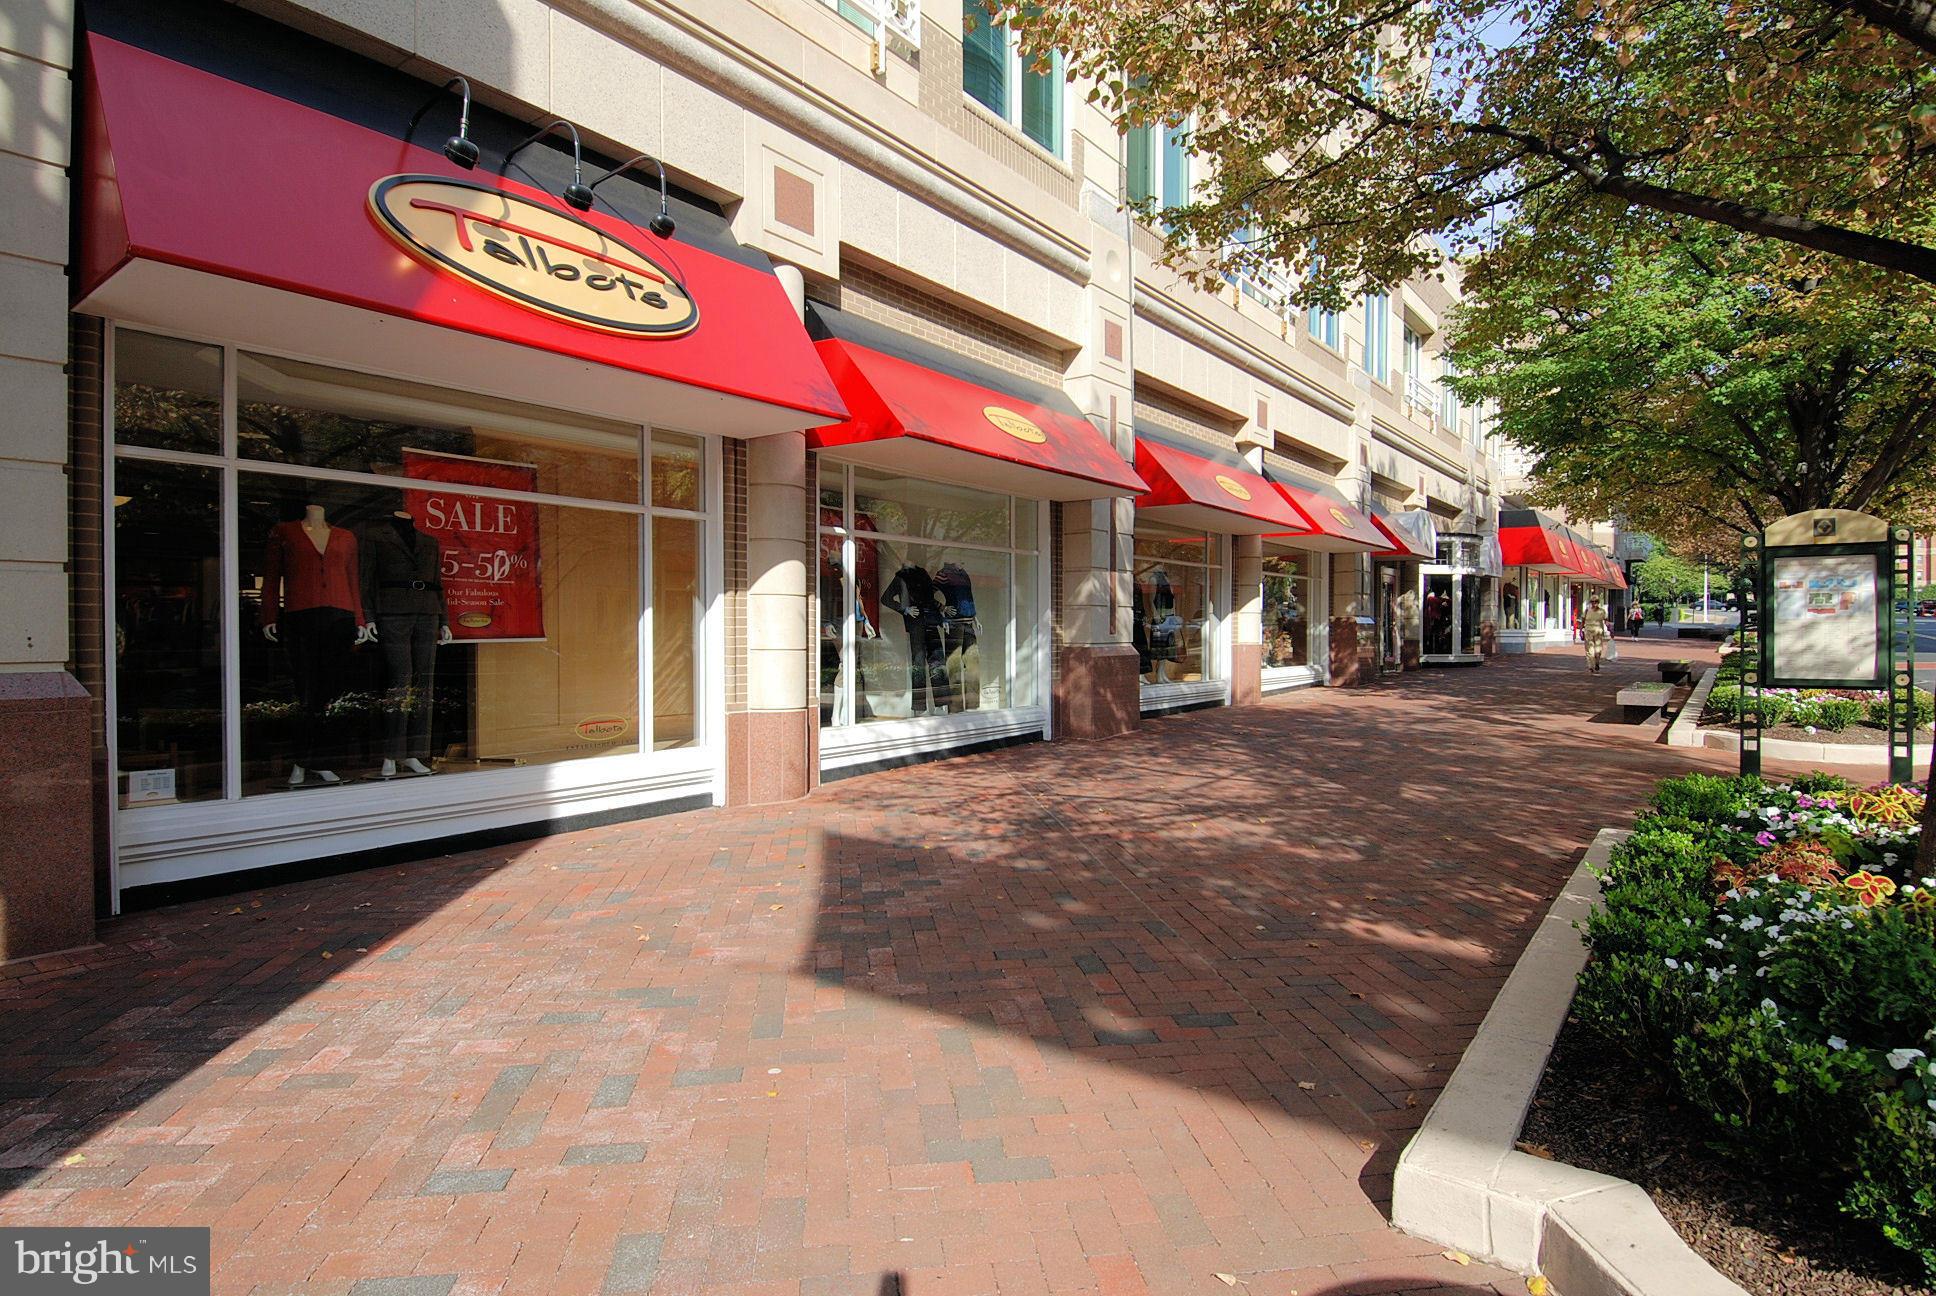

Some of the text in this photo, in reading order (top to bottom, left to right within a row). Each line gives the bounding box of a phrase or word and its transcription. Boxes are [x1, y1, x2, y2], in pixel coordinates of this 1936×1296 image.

[410, 198, 669, 309] Talbots
[425, 498, 517, 534] SALE
[447, 588, 499, 597] Our Fabulous
[489, 598, 505, 606] Sale
[579, 719, 625, 735] Talbots
